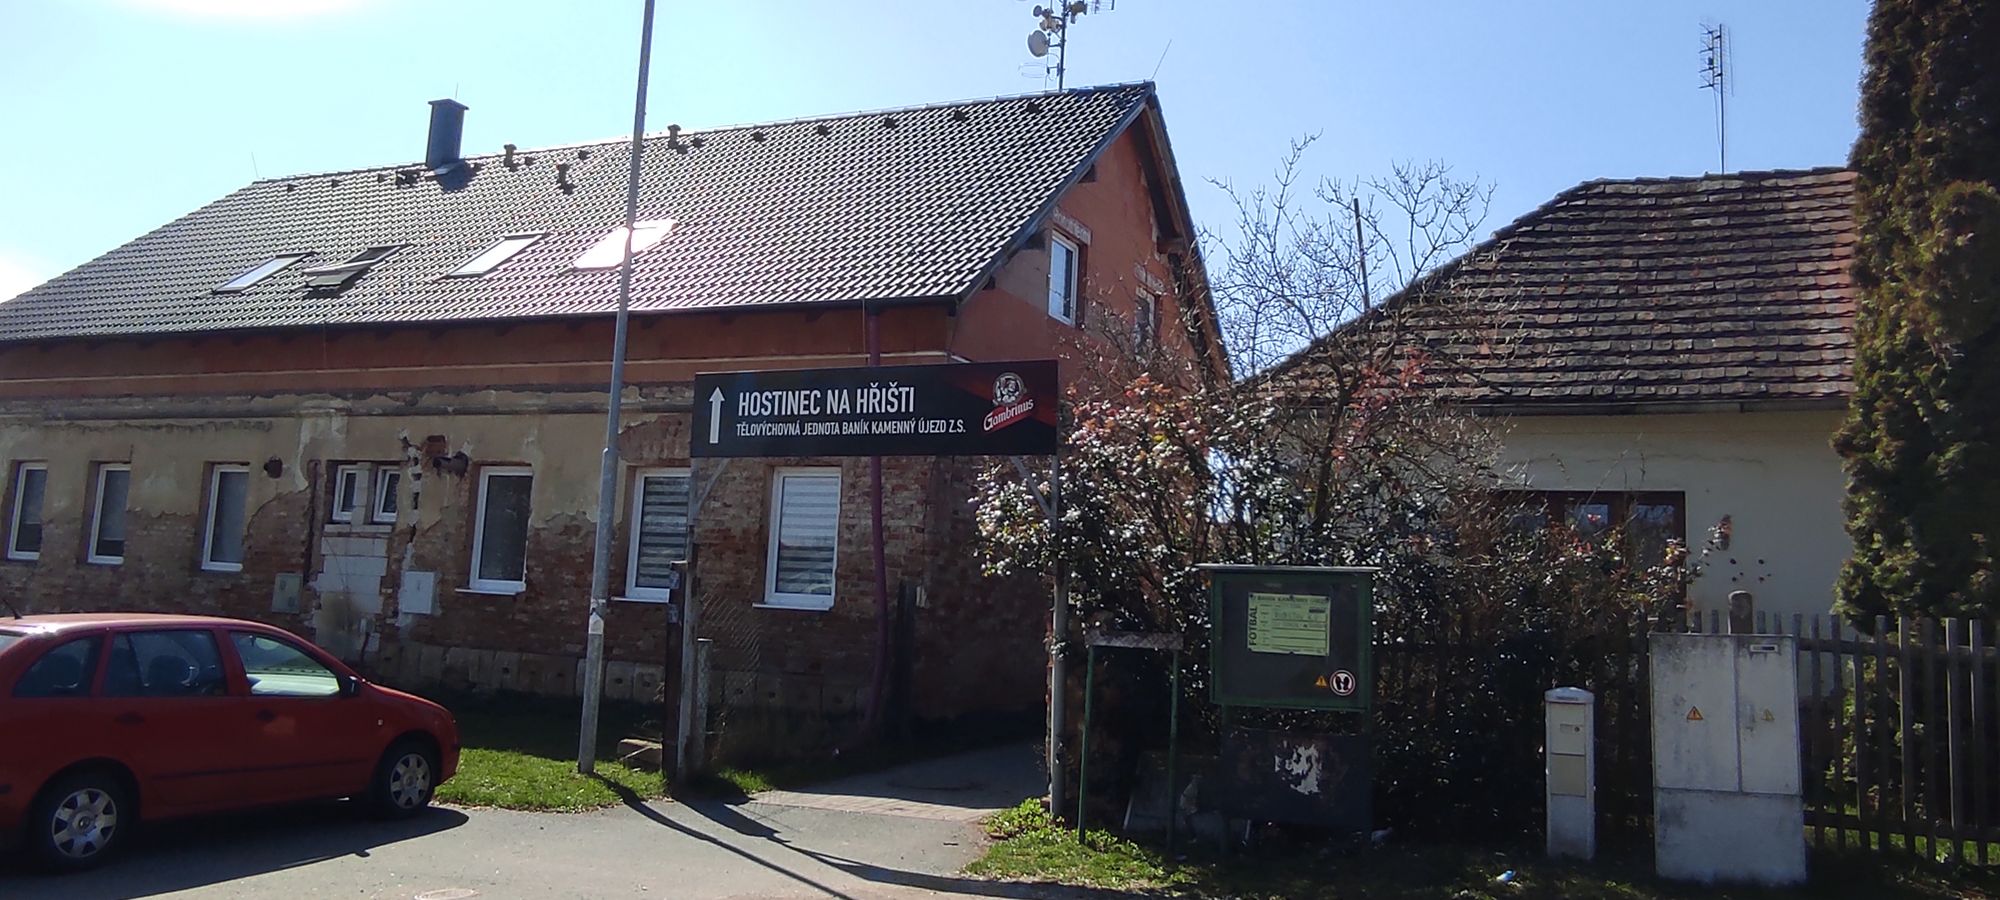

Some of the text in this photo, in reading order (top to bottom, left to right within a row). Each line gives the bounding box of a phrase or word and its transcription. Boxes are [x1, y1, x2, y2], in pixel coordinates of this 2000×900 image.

[738, 382, 916, 417] HOSTINEC NA HŘIŠTI
[983, 399, 1035, 431] Gambrinus
[736, 416, 967, 437] TĚLOVÝCHOVNÁ JEDNOTA BANÍK KAMENNÝ ÚJEZD Z.S.
[1248, 606, 1258, 646] FOTBAL
